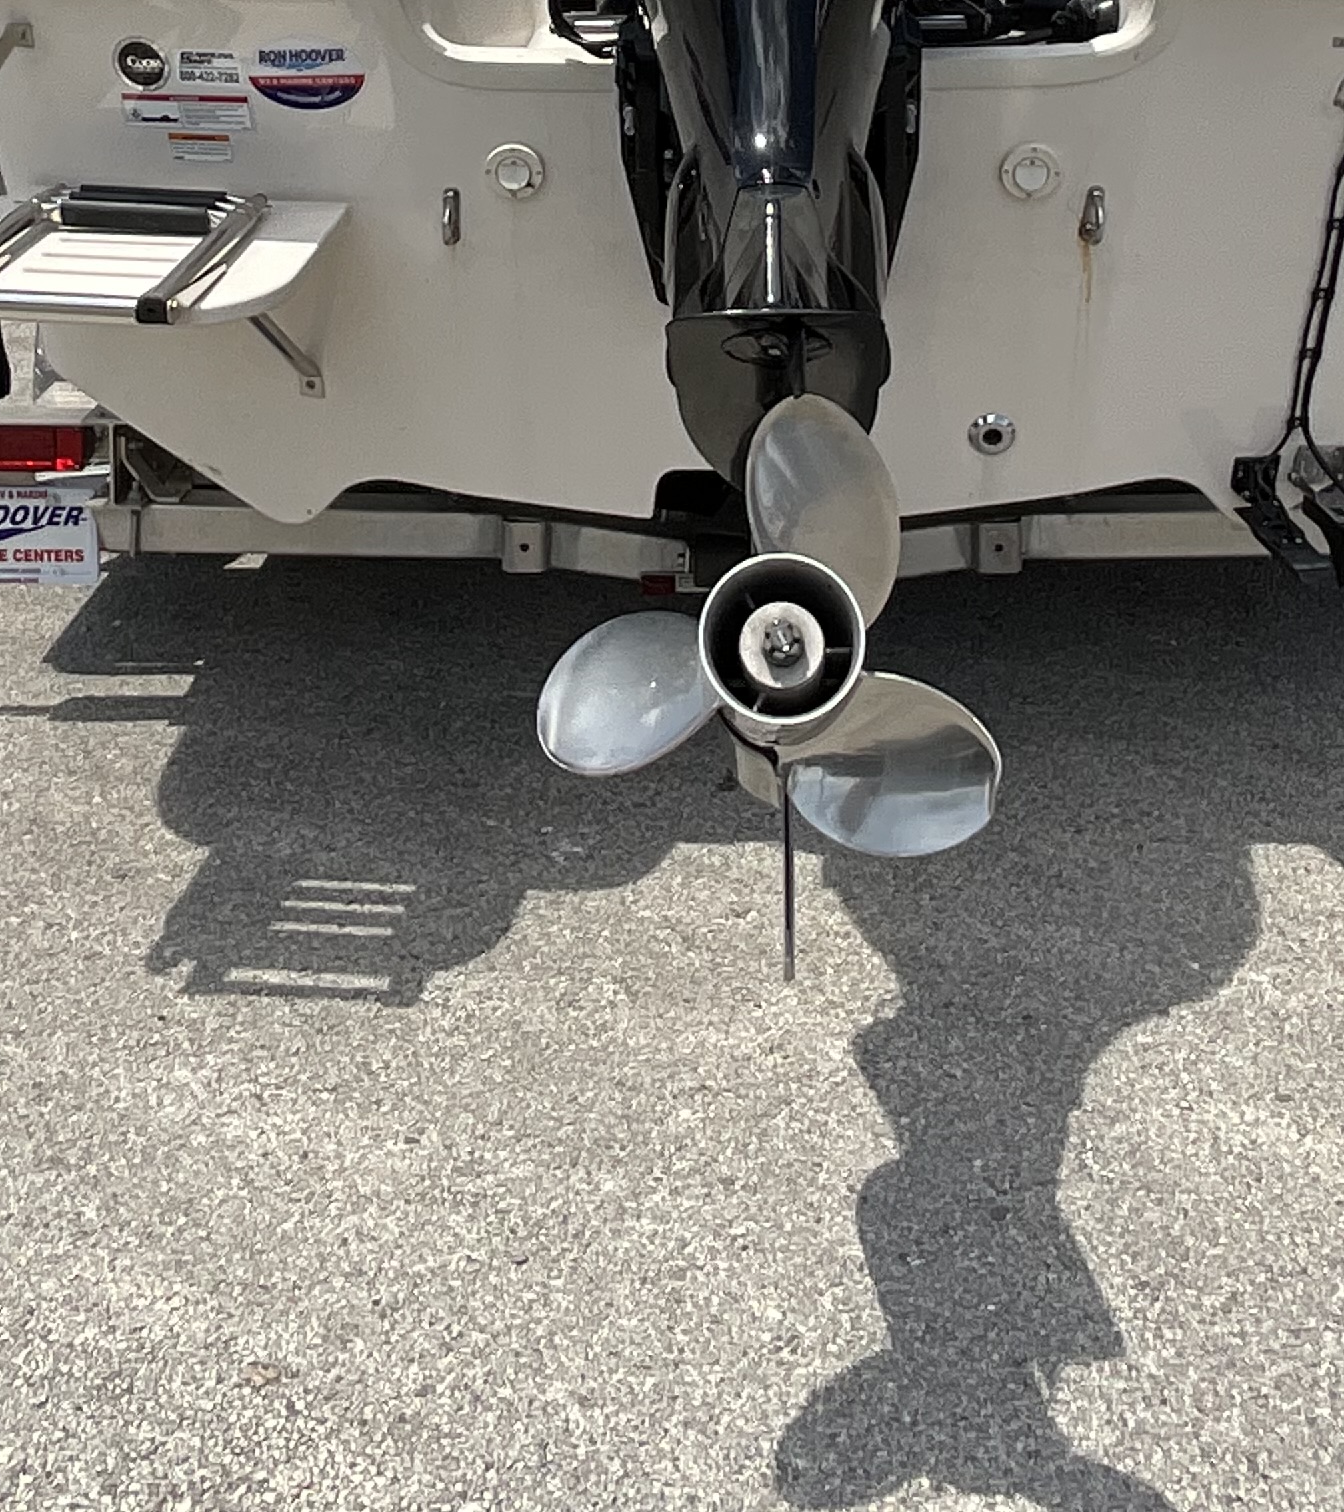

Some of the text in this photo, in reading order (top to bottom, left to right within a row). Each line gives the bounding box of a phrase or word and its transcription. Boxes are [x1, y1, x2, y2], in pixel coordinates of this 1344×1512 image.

[258, 48, 346, 65] RON HOOVER
[12, 549, 85, 563] CENTERS
